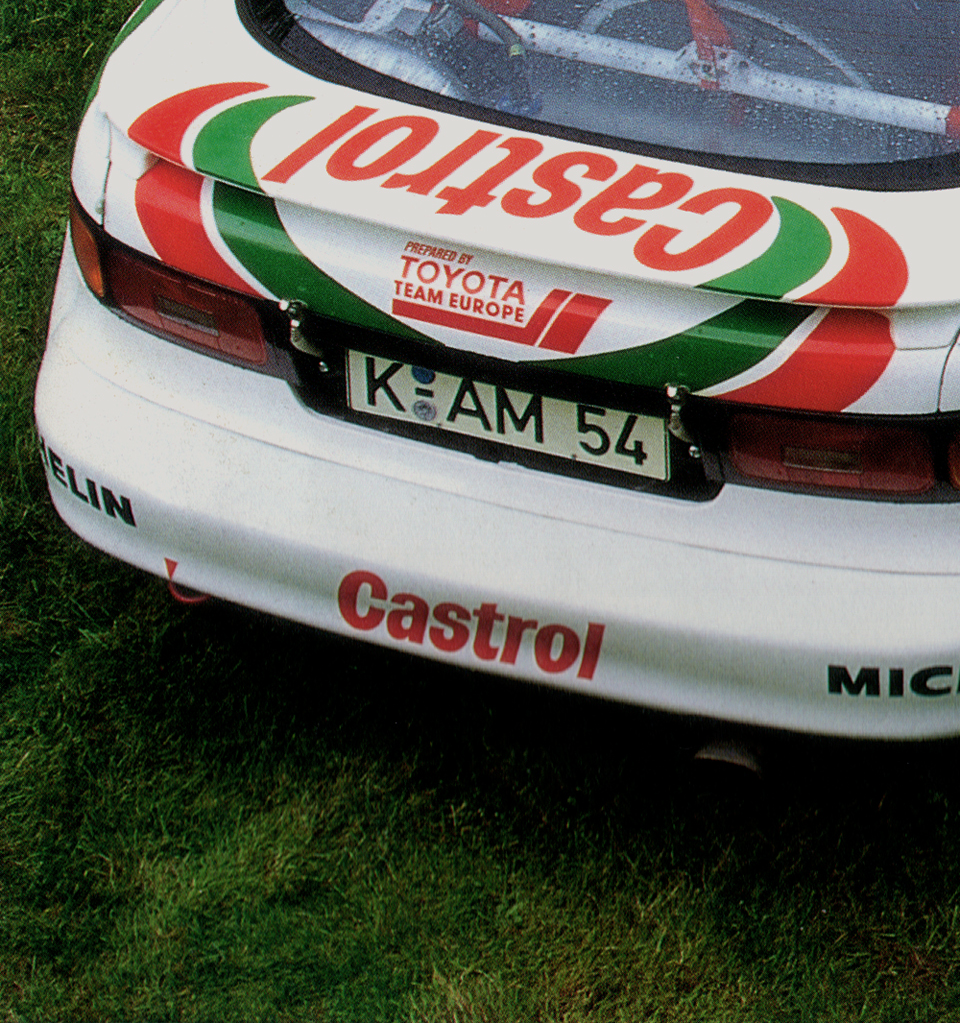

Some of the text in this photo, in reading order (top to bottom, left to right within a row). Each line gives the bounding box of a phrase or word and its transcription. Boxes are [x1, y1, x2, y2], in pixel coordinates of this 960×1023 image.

[260, 104, 775, 272] Castrol
[400, 254, 525, 305] TOYOTA
[404, 240, 474, 265] PREPARED BY
[394, 279, 525, 323] TEAM EUROPE
[575, 403, 648, 466] 54
[337, 569, 606, 681] Castrol
